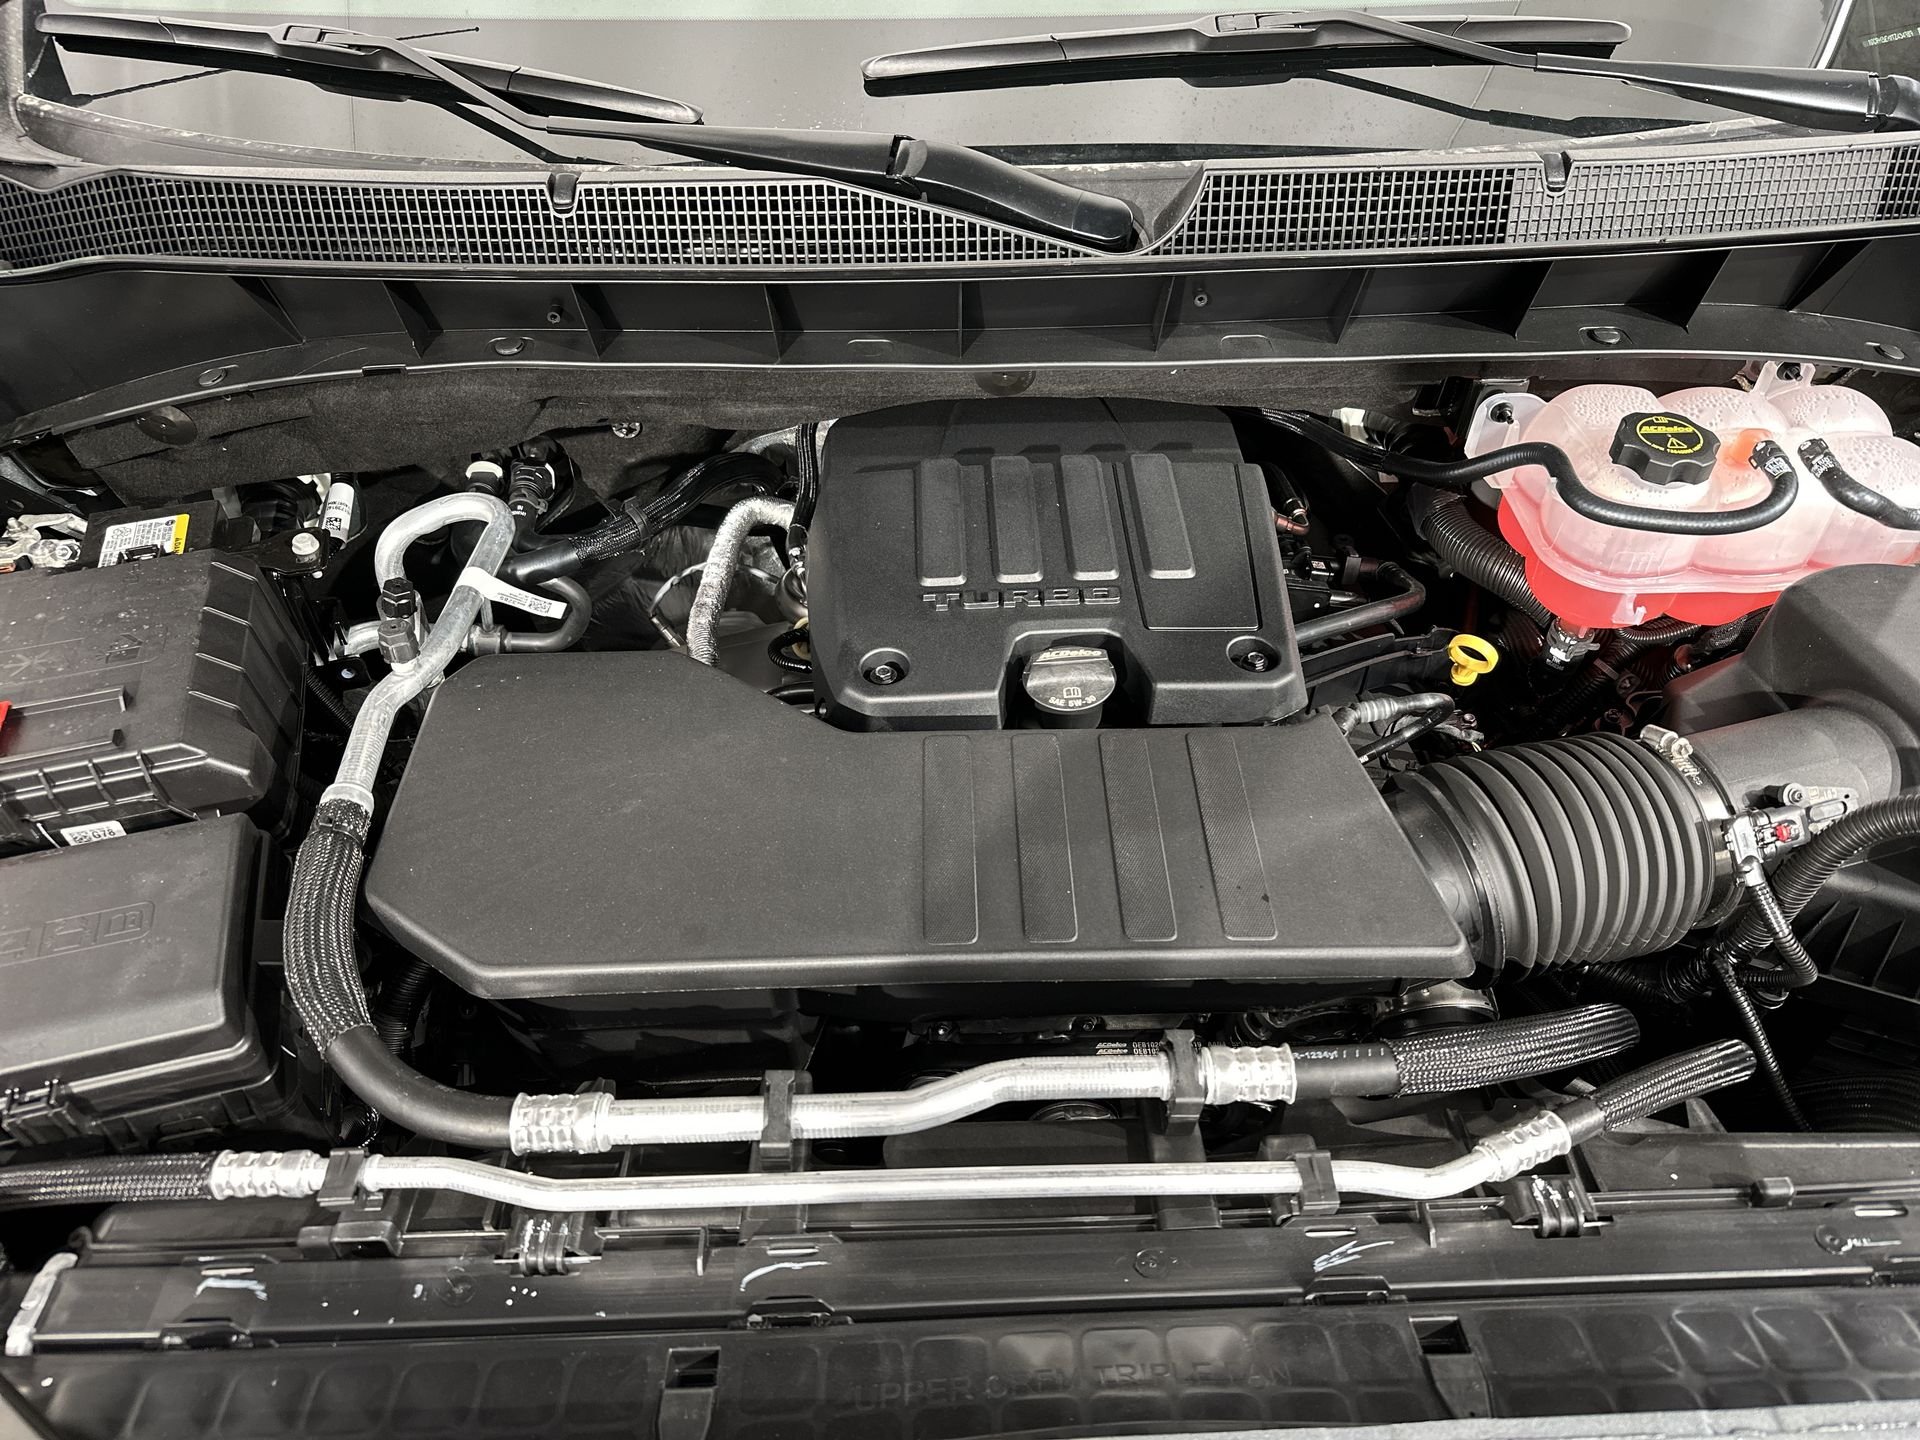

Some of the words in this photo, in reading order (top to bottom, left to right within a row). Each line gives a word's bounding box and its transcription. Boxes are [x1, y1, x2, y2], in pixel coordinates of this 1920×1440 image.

[922, 586, 1121, 612] TURBO
[1036, 649, 1102, 661] ACDelco
[1048, 696, 1066, 706] SAE
[1068, 695, 1097, 707] 5W-30
[91, 828, 116, 839] G78
[854, 1376, 974, 1411] UPPER
